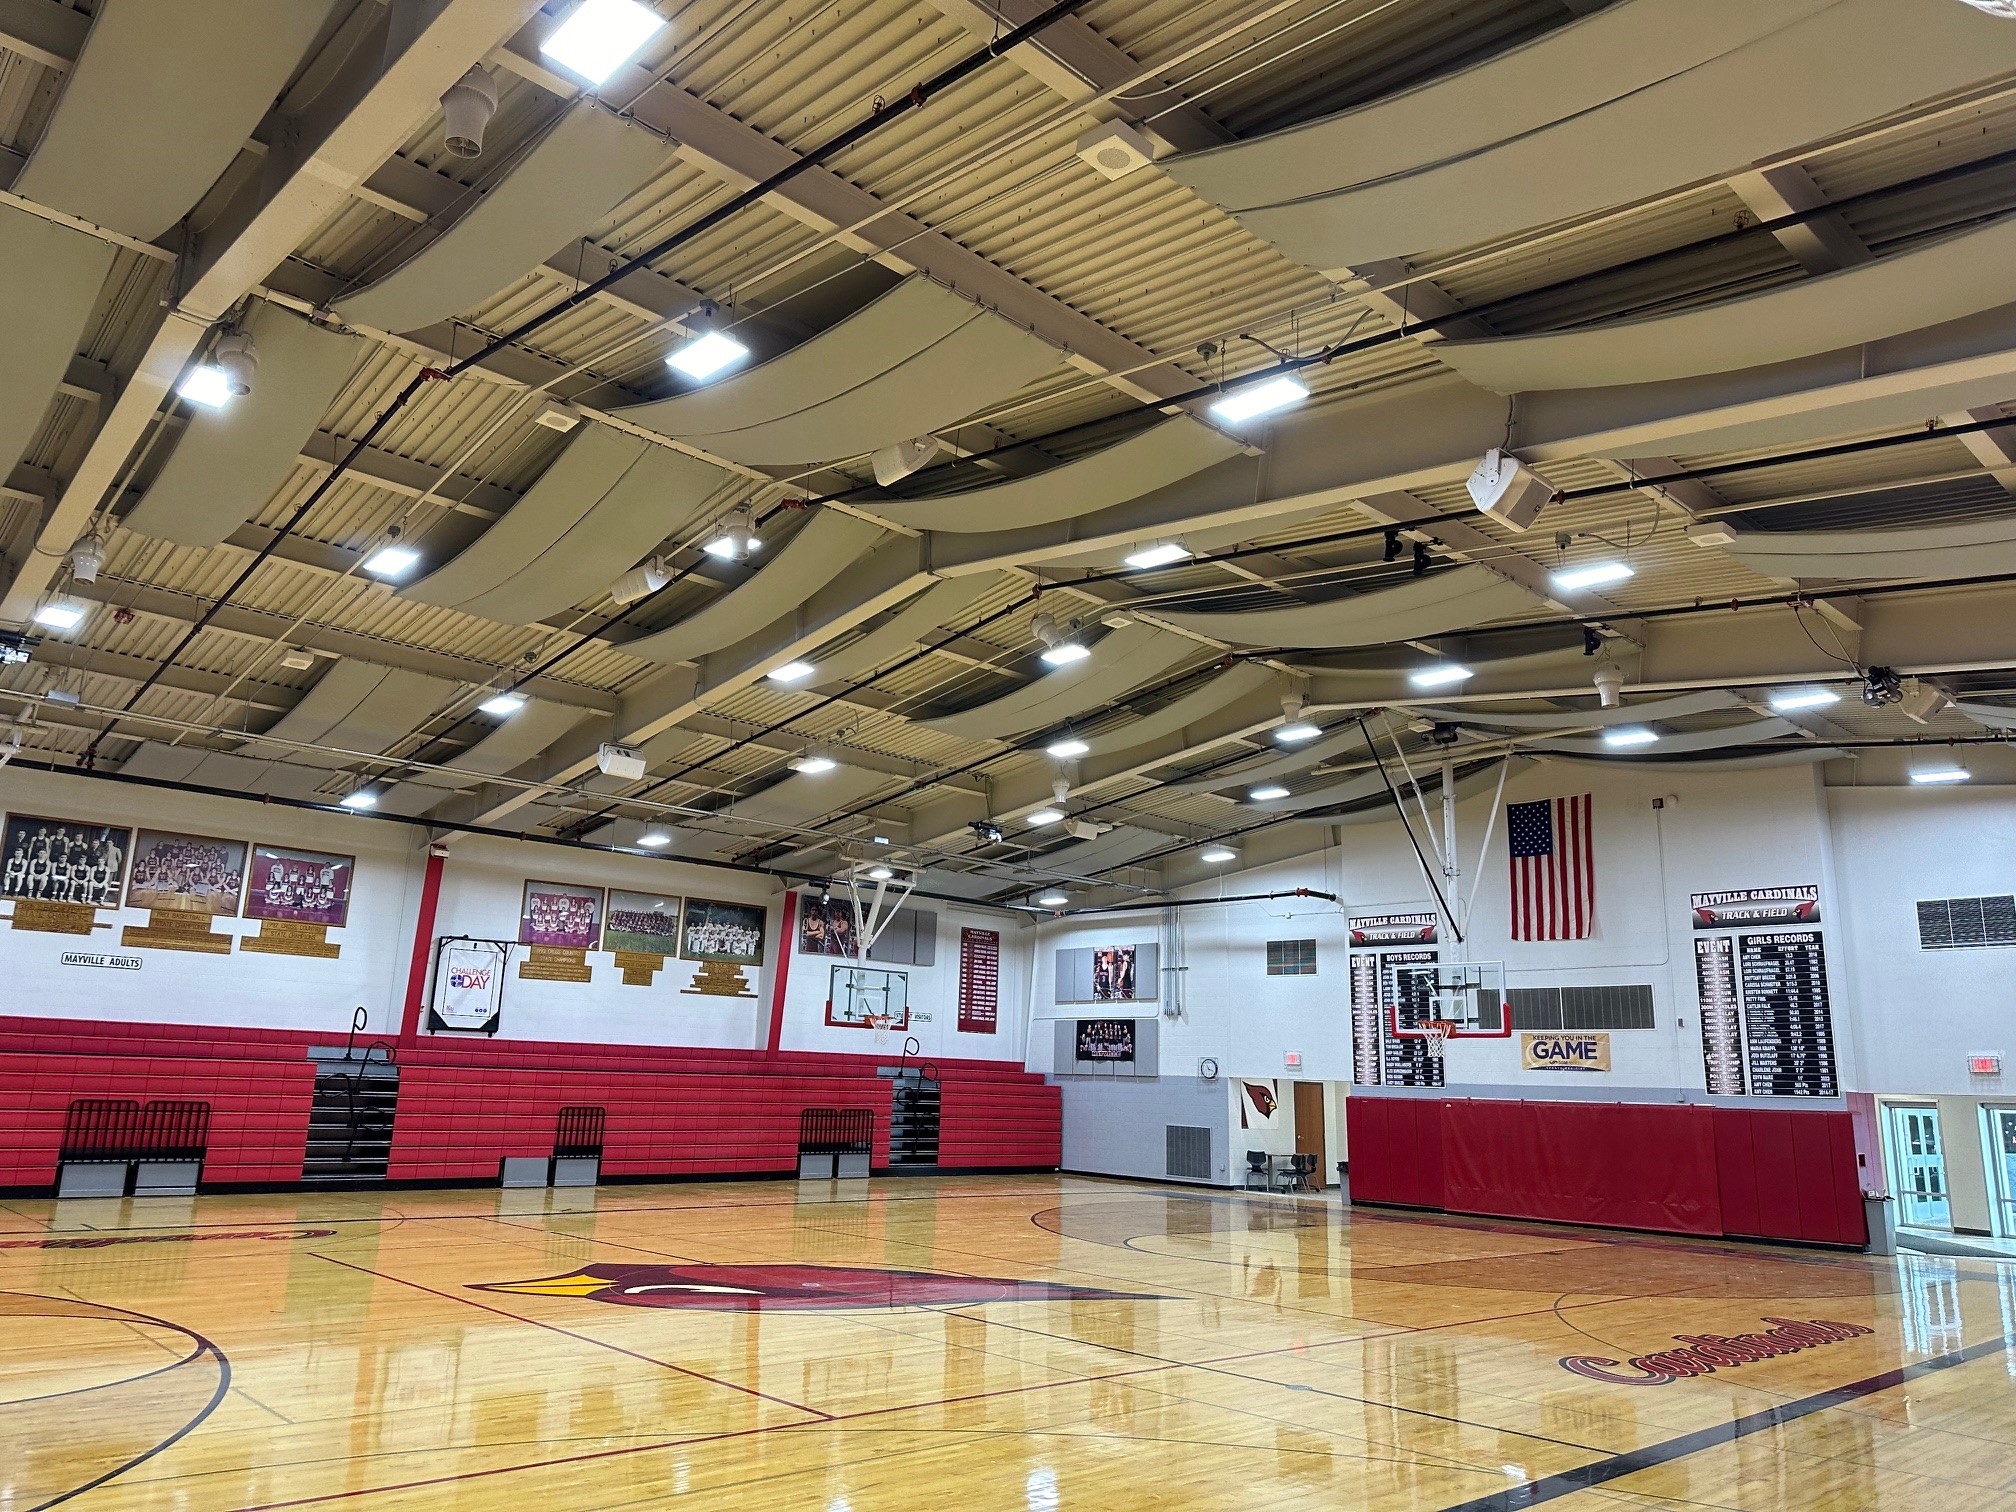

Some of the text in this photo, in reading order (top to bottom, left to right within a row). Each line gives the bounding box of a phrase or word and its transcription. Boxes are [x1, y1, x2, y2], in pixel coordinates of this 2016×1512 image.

[1692, 886, 1818, 909] MAYVILLE CARDINALS
[1722, 908, 1787, 920] TRACK & FIELD
[1349, 914, 1436, 930] MAYVILLE CARDINALS
[1747, 933, 1814, 946] GIRLS RECORDS
[1696, 940, 1731, 955] EVENT
[64, 954, 140, 968] MAYVILLE ADULTS
[1351, 956, 1375, 968] EVENT
[1386, 952, 1431, 962] BOYS RECORDS
[451, 966, 491, 977] CHALLENGE
[461, 975, 491, 990] DAY
[1533, 1041, 1597, 1060] GAME
[1558, 1317, 1875, 1386] Cardinals
